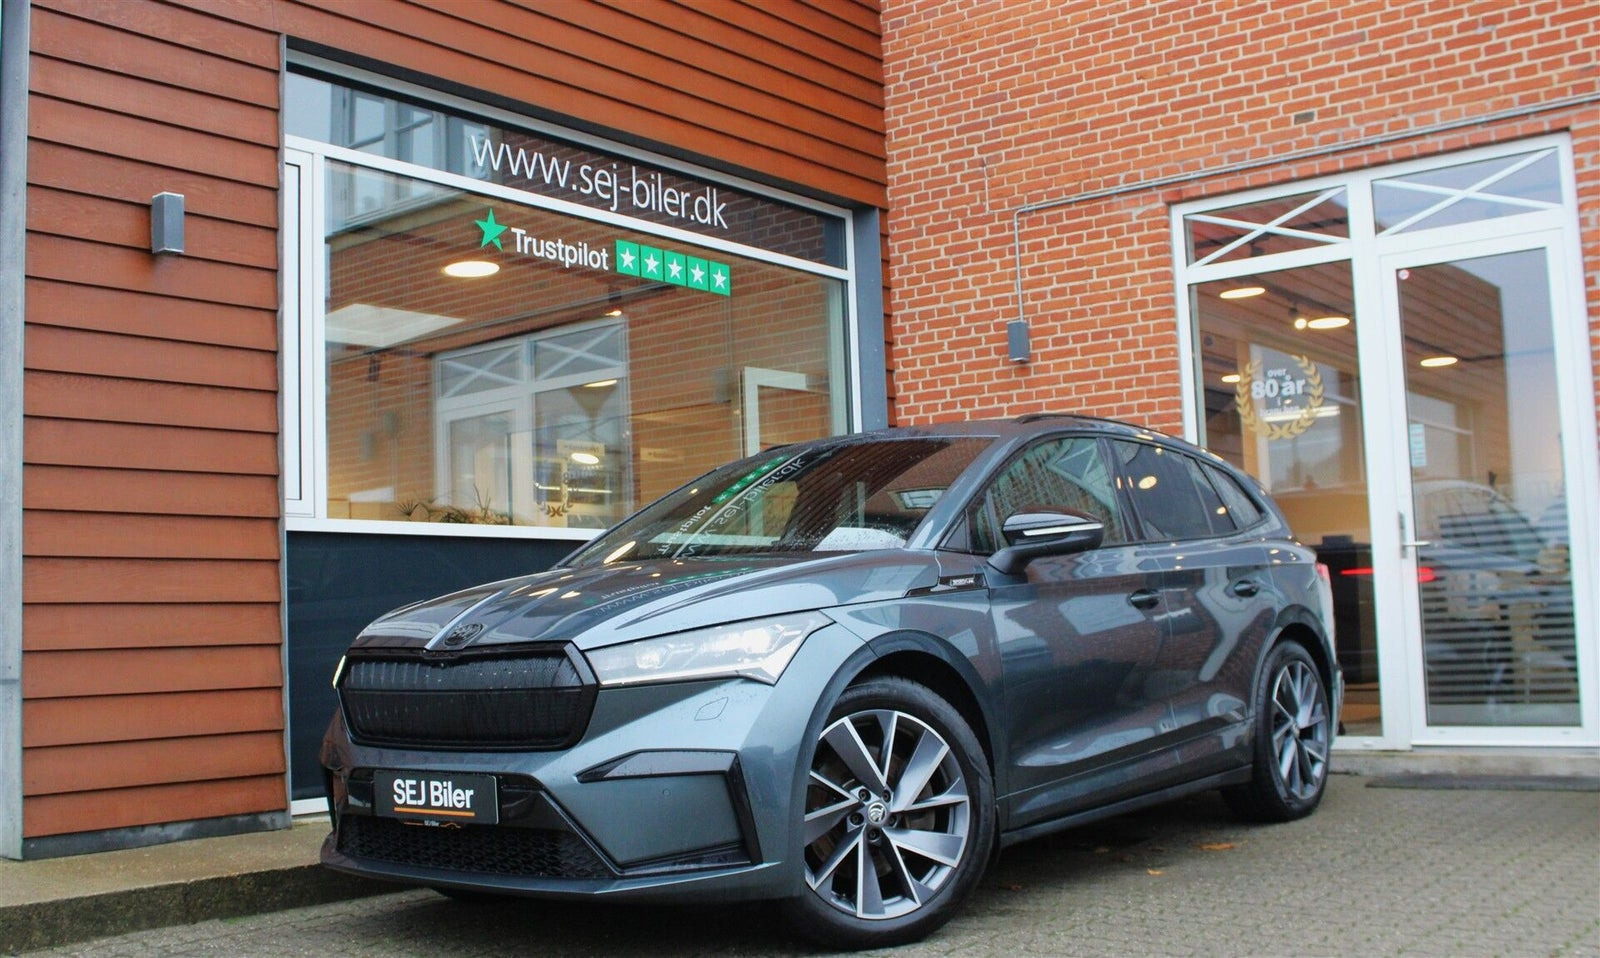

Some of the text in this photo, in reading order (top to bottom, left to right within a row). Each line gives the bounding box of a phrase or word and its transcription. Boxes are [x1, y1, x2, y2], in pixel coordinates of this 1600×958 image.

[471, 135, 728, 229] www.sej-biler.dk
[511, 227, 609, 271] Trustpilot
[1251, 375, 1306, 399] 80 år
[1267, 368, 1287, 378] over
[393, 779, 474, 808] SEJ Biler
